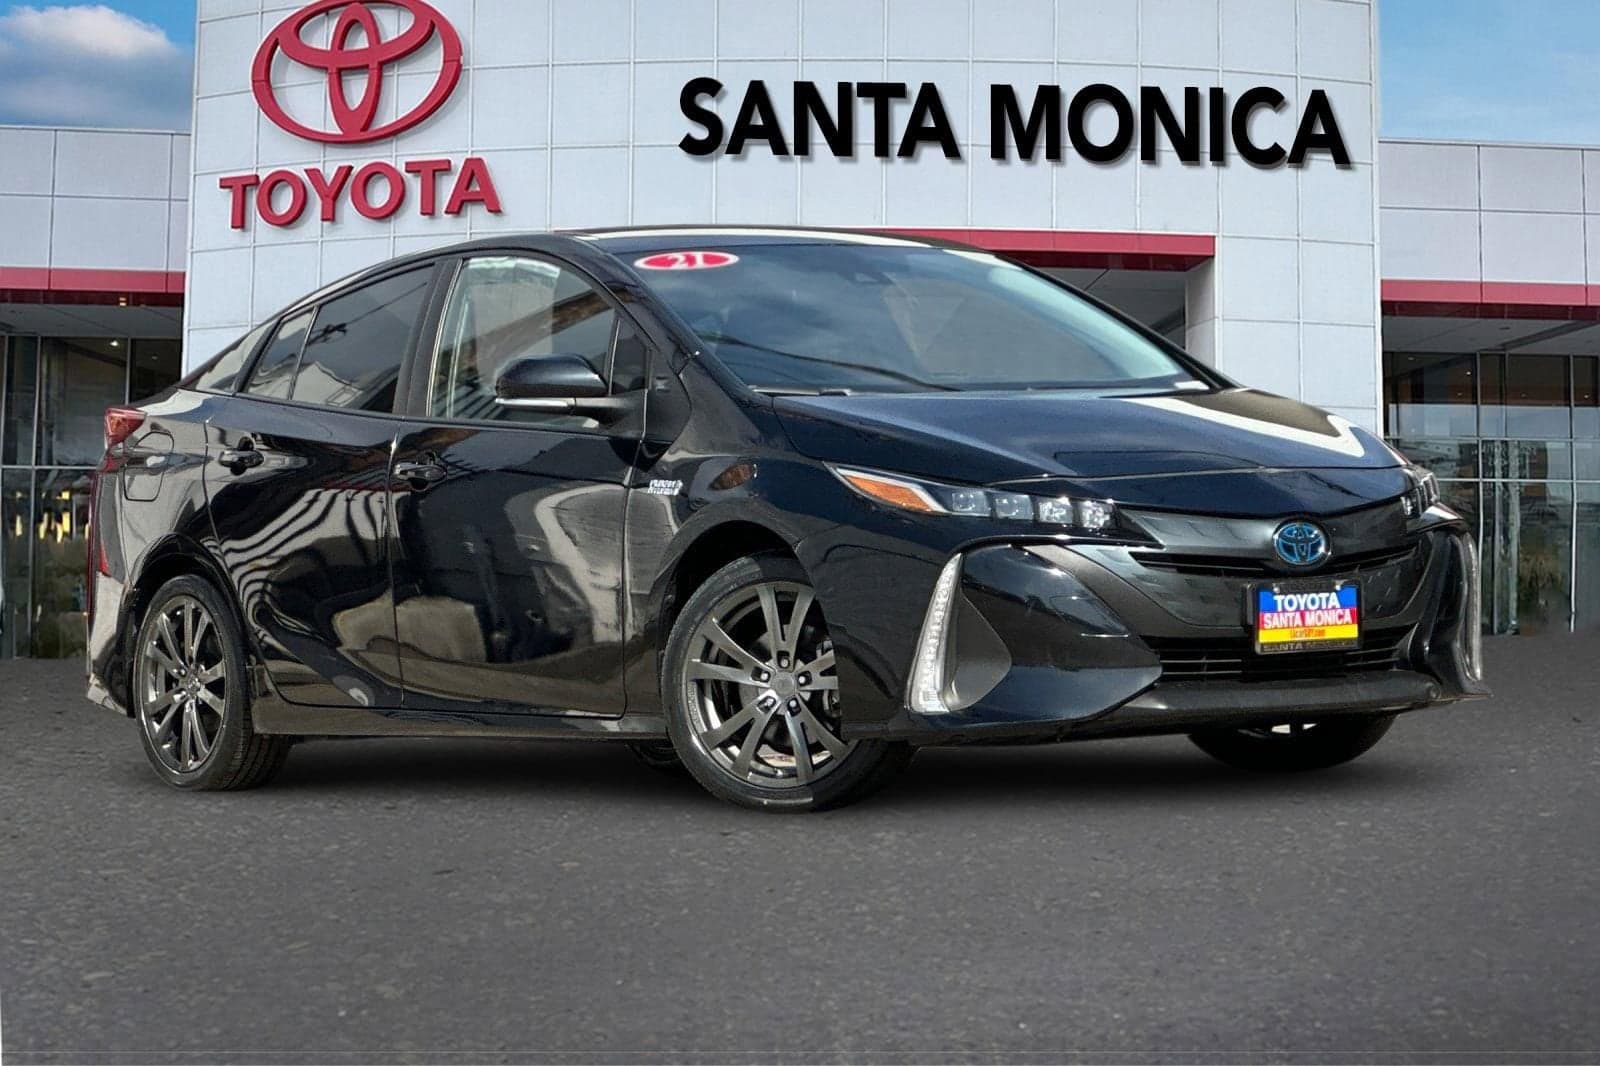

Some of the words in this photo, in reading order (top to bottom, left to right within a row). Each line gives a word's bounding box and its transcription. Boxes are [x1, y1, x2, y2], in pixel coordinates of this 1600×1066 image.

[679, 77, 961, 158] SANTA
[990, 83, 1352, 168] MONICA
[219, 157, 502, 229] TOYOTA
[667, 253, 704, 269] 21
[1273, 592, 1341, 612] TOYOTA
[1263, 612, 1303, 629] SANTA
[1305, 608, 1352, 626] MONICA
